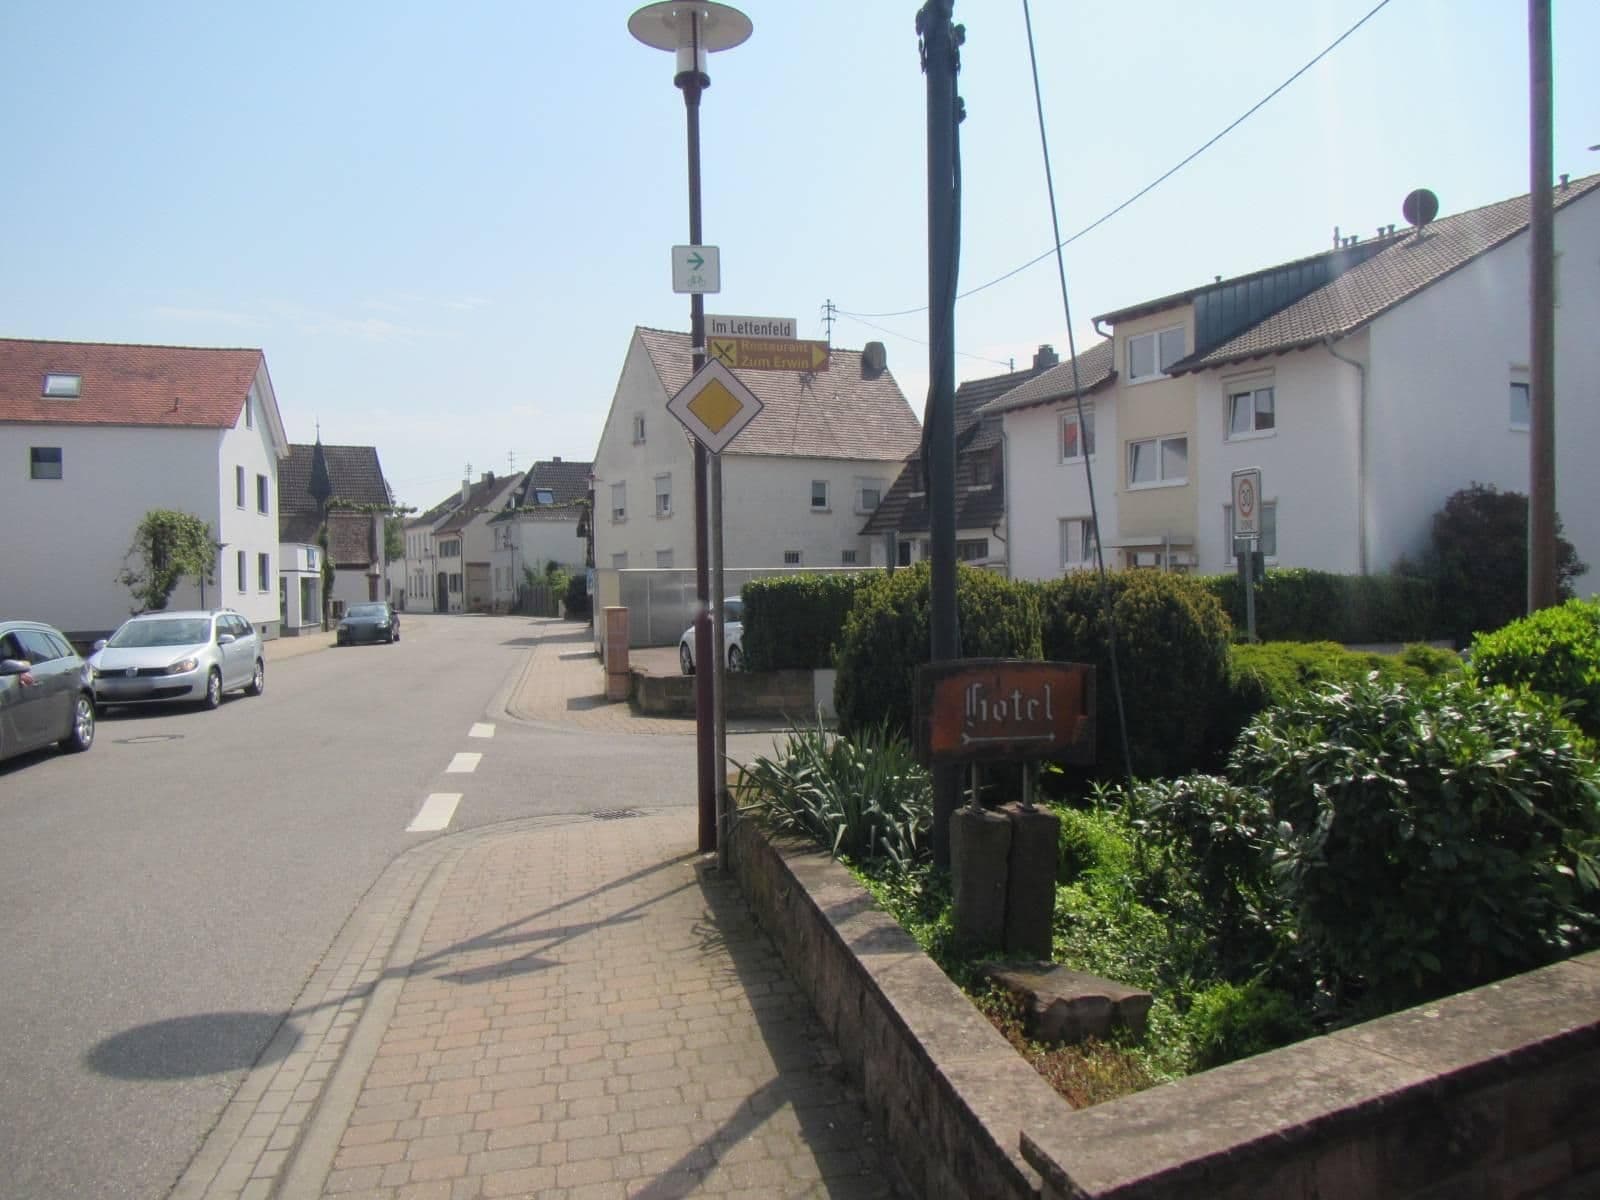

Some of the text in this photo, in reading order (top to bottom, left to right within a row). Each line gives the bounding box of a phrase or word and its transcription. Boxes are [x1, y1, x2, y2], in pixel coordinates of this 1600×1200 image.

[712, 319, 791, 337] Im Lettenfeld
[774, 358, 809, 369] Erwin
